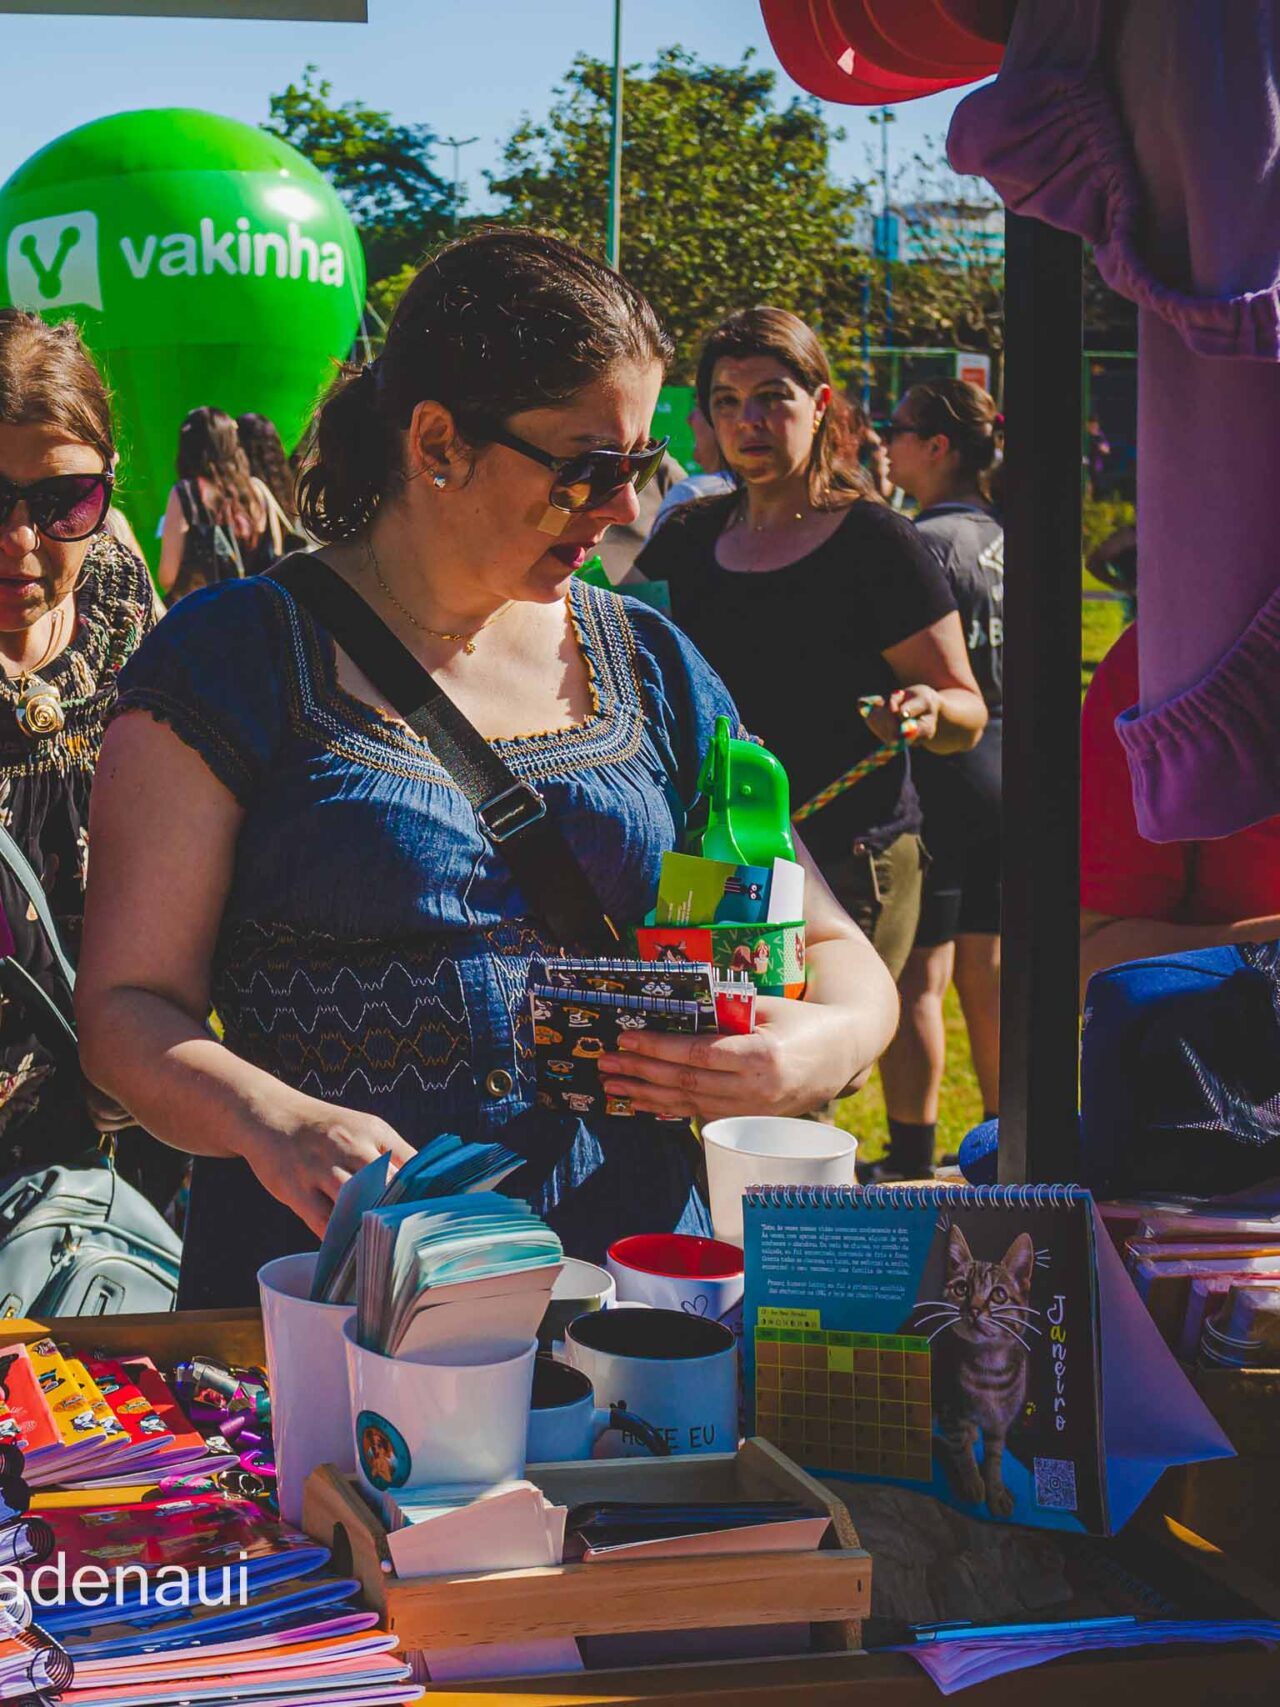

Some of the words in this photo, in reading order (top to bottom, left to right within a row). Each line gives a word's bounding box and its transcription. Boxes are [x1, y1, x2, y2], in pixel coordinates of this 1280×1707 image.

[120, 217, 344, 288] vakinha
[1046, 1295, 1067, 1431] Janeiro
[689, 1424, 716, 1448] EU
